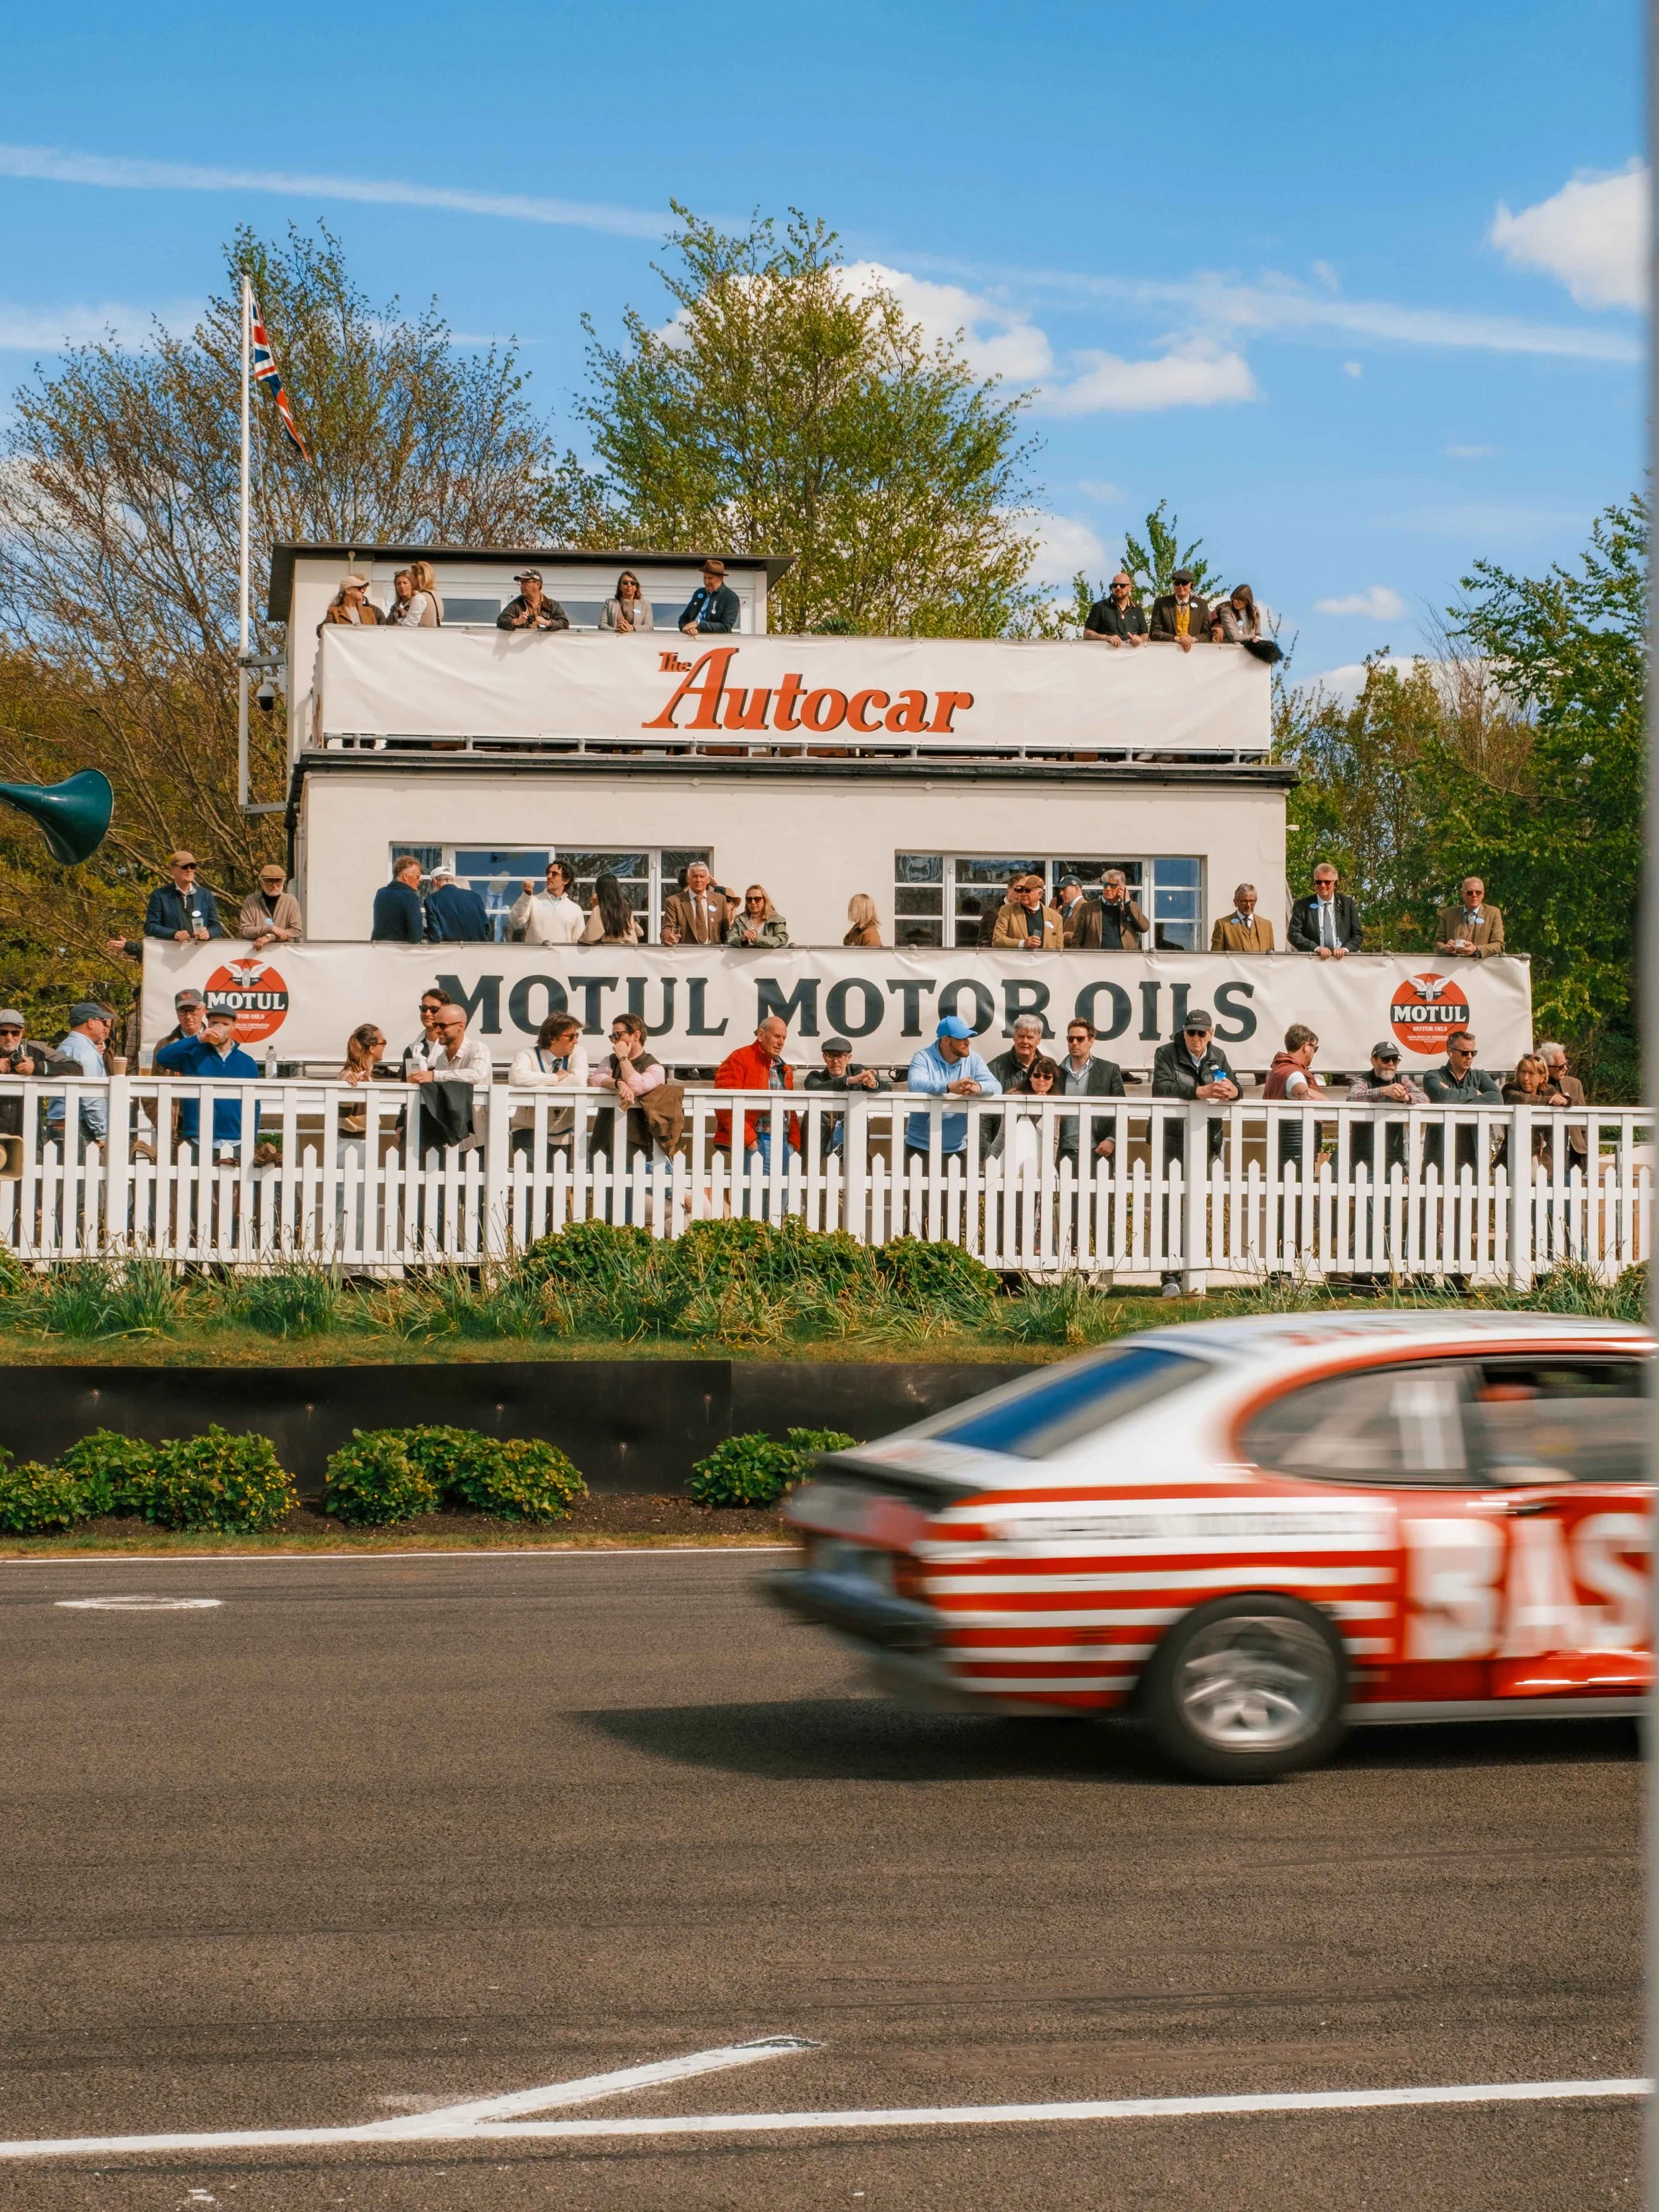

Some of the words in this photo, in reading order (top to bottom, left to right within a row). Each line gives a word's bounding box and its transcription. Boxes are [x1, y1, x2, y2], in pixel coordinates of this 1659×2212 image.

[658, 652, 691, 671] The
[642, 647, 974, 732] Autocar
[207, 993, 285, 1010] MOTUL
[435, 975, 729, 1036] MOTUL
[754, 978, 1055, 1040] MOTOR
[1394, 1006, 1466, 1022] MOTUL
